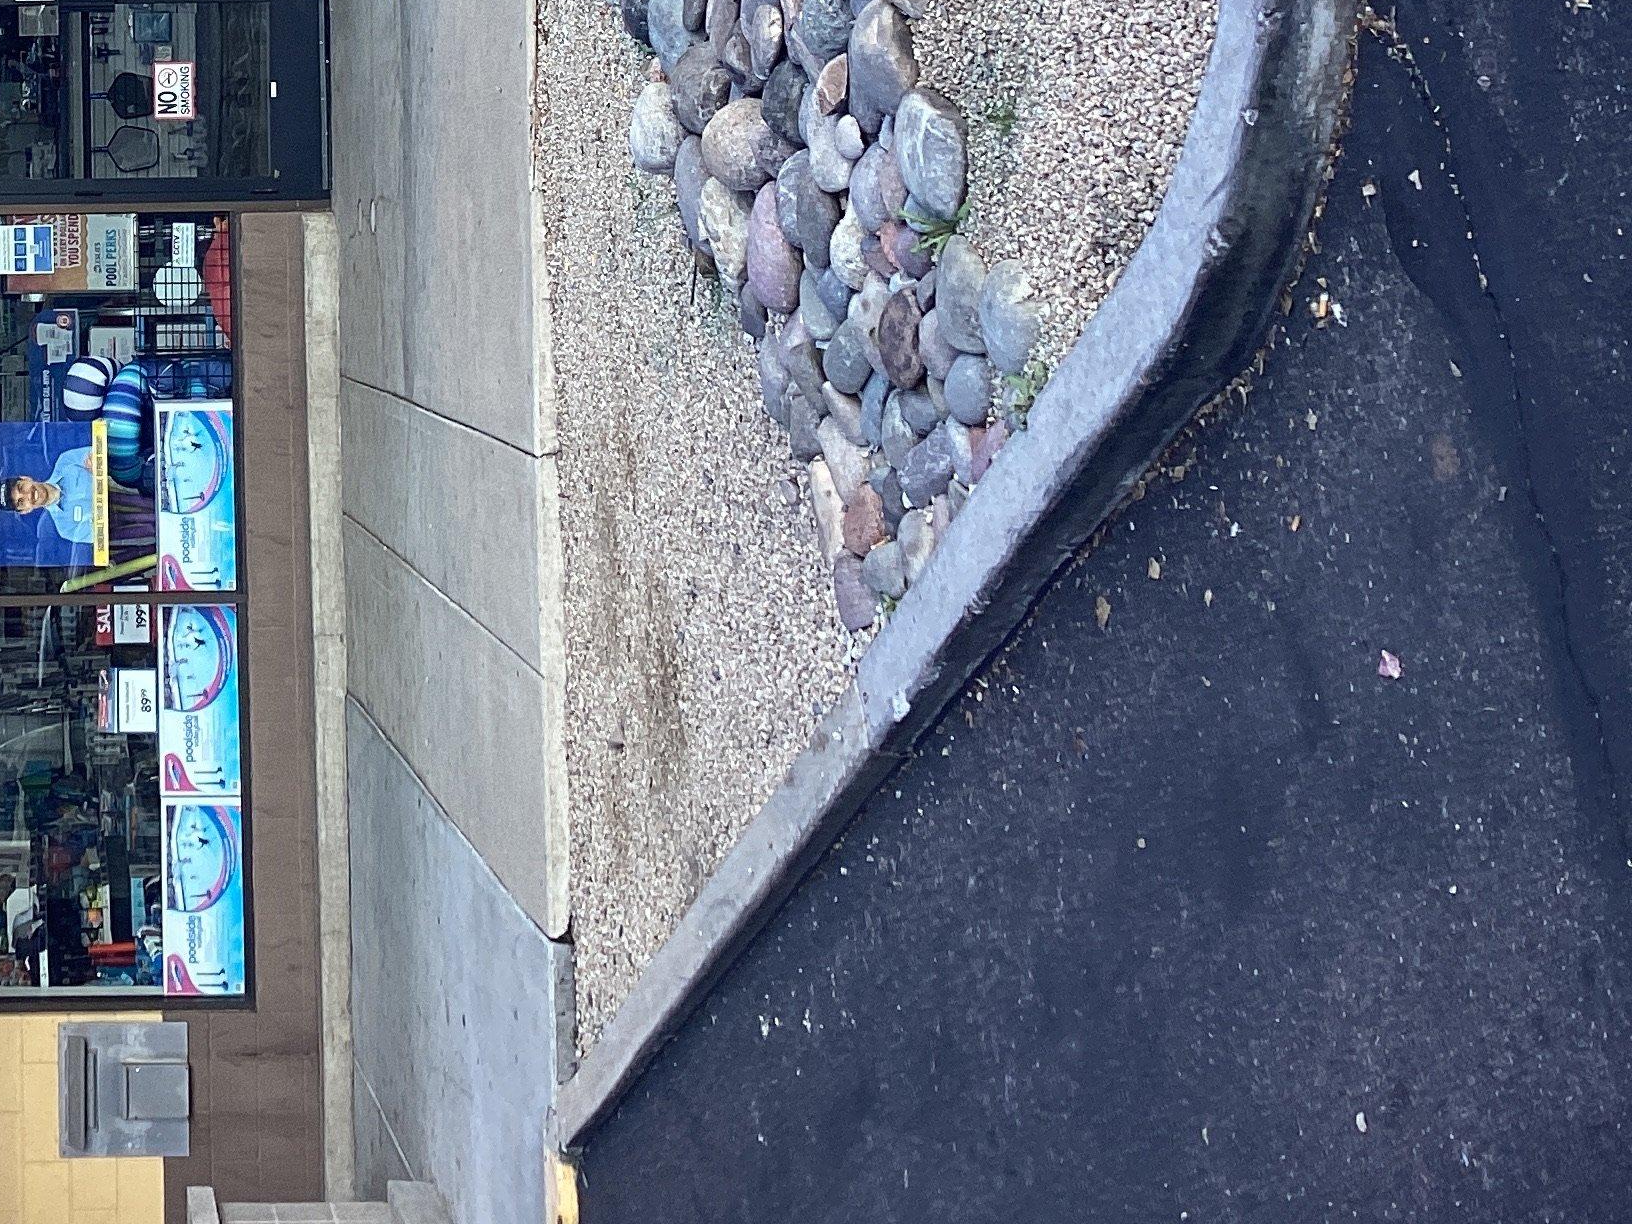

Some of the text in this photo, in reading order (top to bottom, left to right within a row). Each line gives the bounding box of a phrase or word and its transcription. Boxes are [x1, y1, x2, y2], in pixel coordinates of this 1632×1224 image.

[157, 91, 178, 115] NO
[180, 66, 191, 115] SMOKING
[68, 214, 79, 266] YOU SPEND
[106, 229, 117, 286] POOL PERKS
[179, 516, 195, 564] poolside
[97, 604, 110, 633] SAL
[183, 715, 196, 763] poolside
[185, 915, 199, 964] poolside
